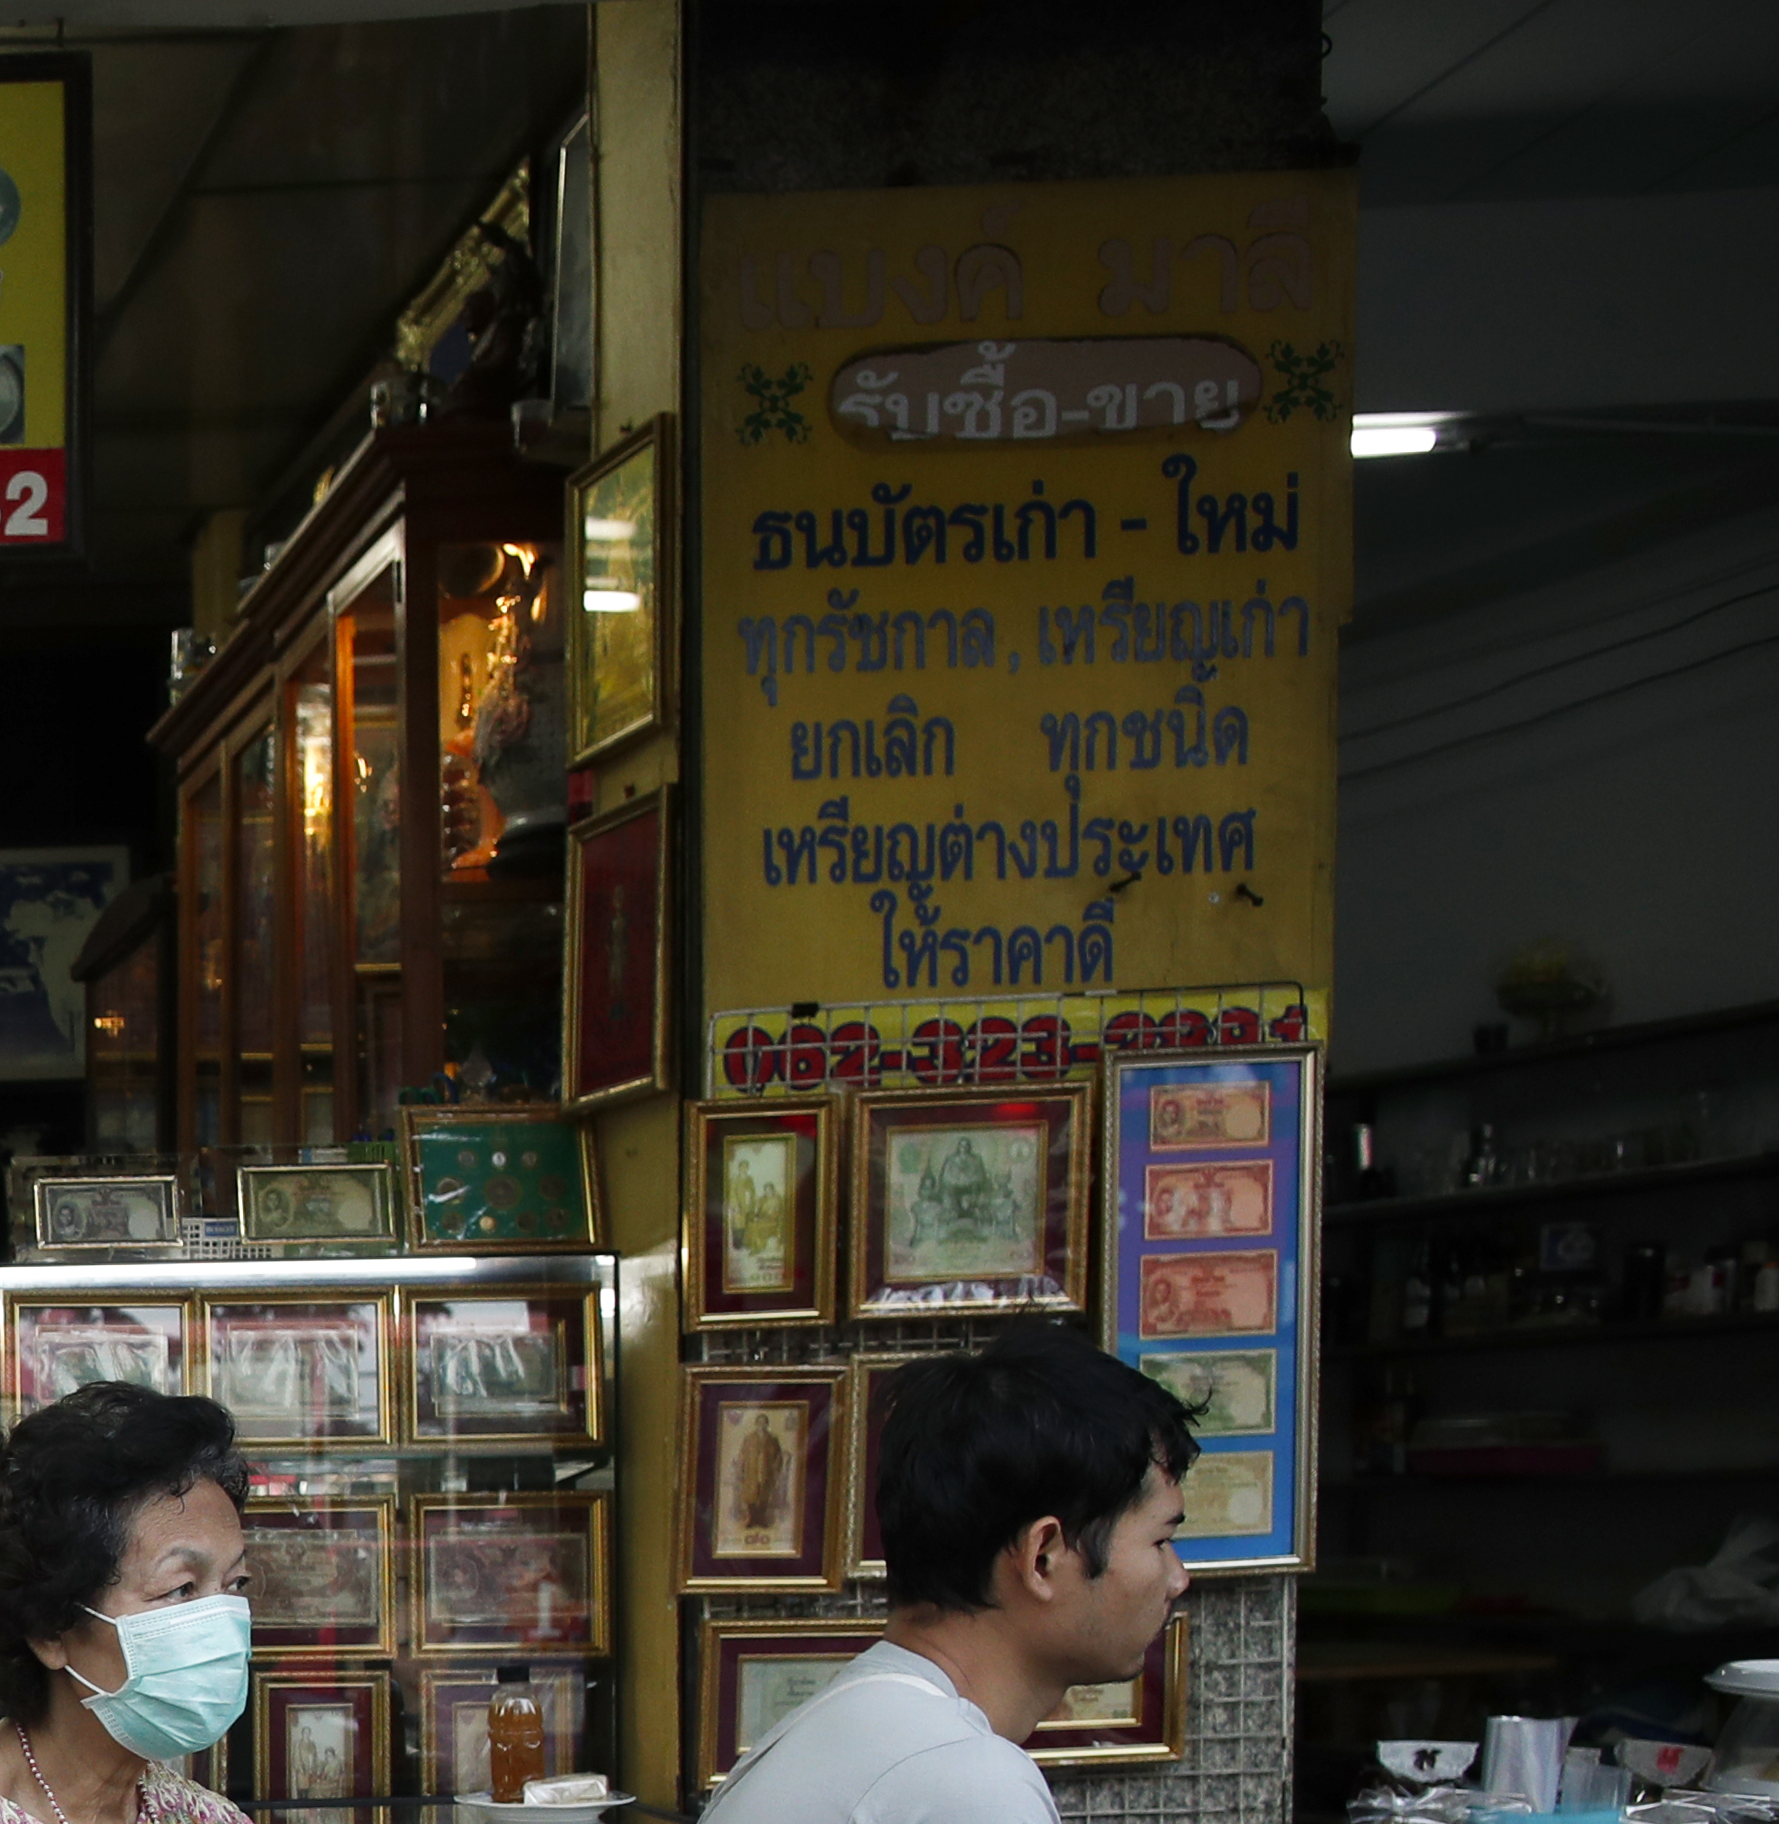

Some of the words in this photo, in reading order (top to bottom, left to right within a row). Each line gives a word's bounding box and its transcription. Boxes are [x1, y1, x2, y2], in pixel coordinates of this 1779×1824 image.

[752, 481, 1097, 571] ธนบัตรเก่า
[1161, 453, 1300, 555] ใหม่
[1038, 576, 1311, 682] เหรียญเก่า
[790, 695, 955, 780] ยกเลิก
[1041, 685, 1250, 800] ทุกชนิด
[762, 797, 1257, 897] เหรียญต่างประเทศ
[870, 889, 1115, 989] ให้ราคาดี
